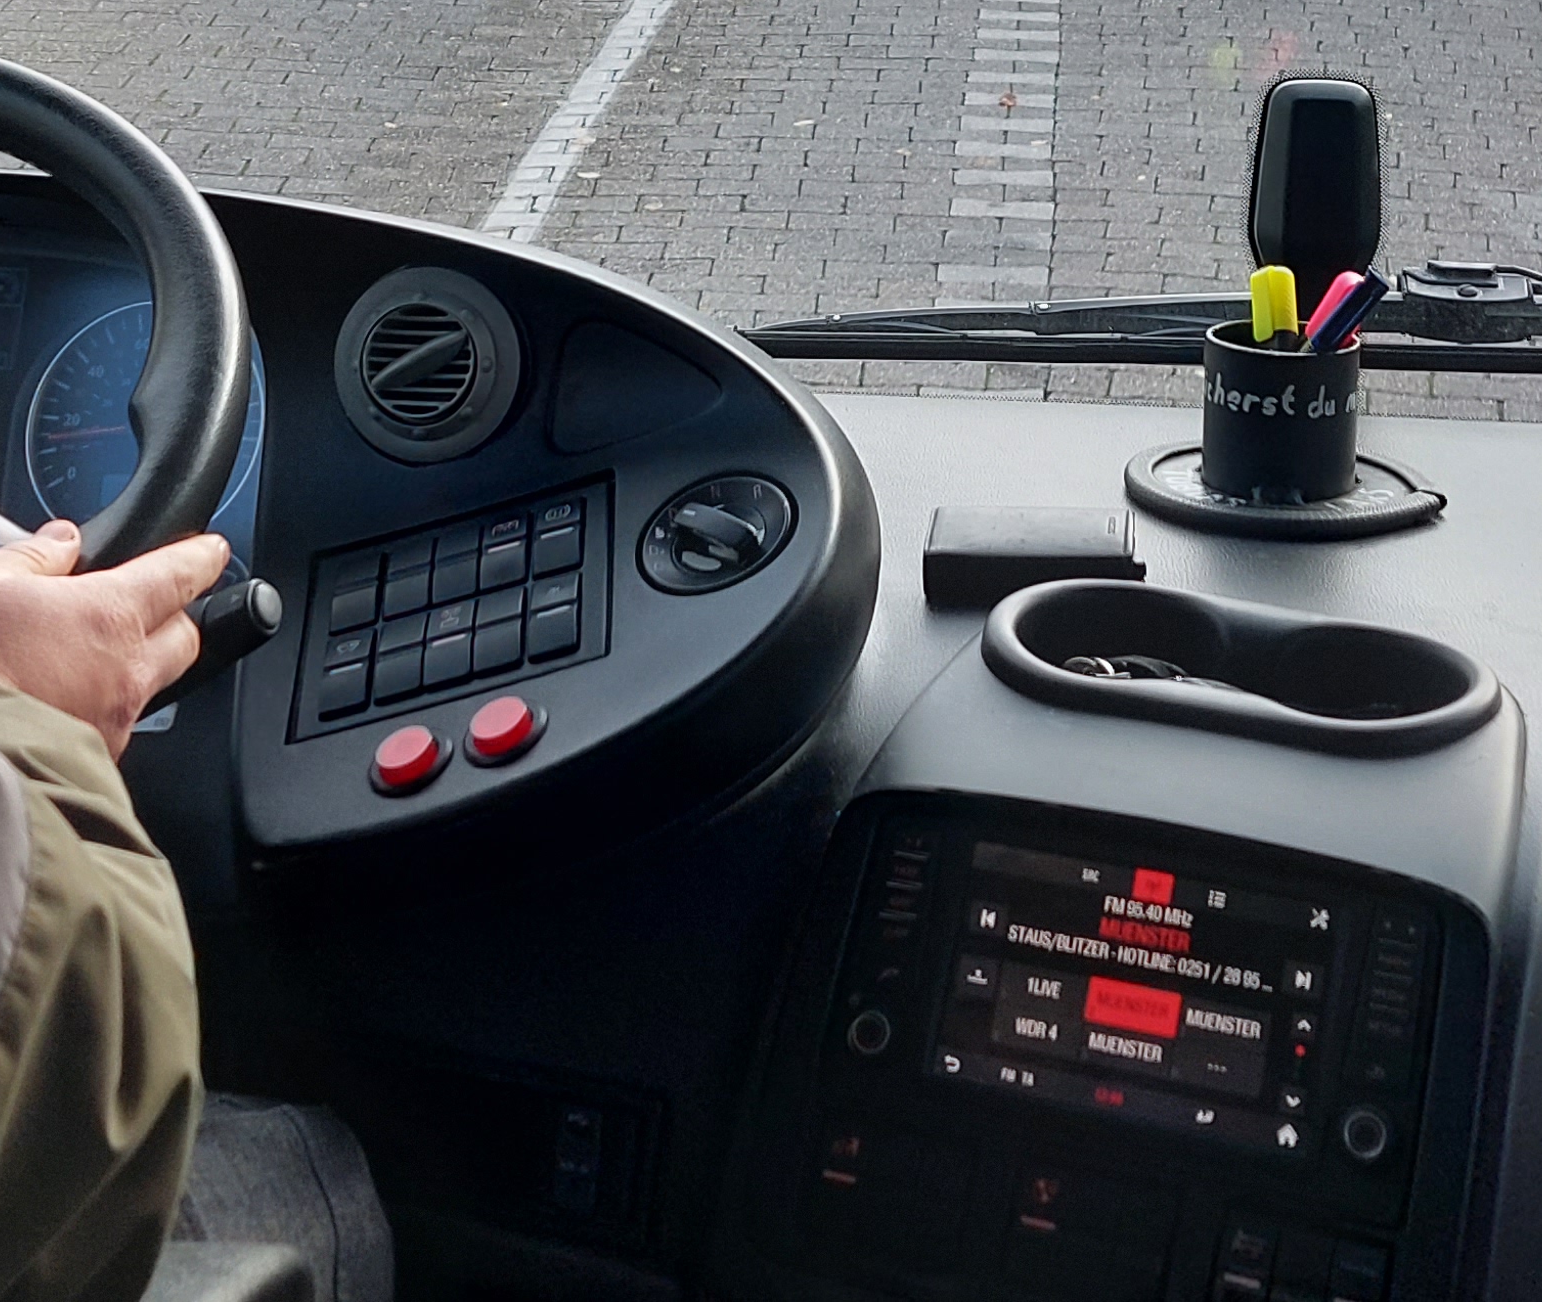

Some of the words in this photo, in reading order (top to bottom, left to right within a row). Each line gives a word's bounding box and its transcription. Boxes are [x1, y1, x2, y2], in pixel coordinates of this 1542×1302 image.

[1307, 384, 1336, 419] du
[63, 413, 81, 426] 20
[67, 466, 77, 480] 0
[1103, 895, 1125, 916] FM
[1126, 902, 1163, 922] 95.40
[1163, 906, 1194, 929] MHz
[1008, 924, 1110, 960] STAUS/BLITZER
[1117, 945, 1176, 974] HOTLINE:
[1098, 916, 1192, 953] MUENSTER
[1027, 976, 1062, 1000] 1LIVE
[1015, 1017, 1047, 1040] WDR
[1047, 1023, 1058, 1042] 4
[1185, 1007, 1262, 1040] MUENSTER
[1088, 1030, 1163, 1064] MUENSTER
